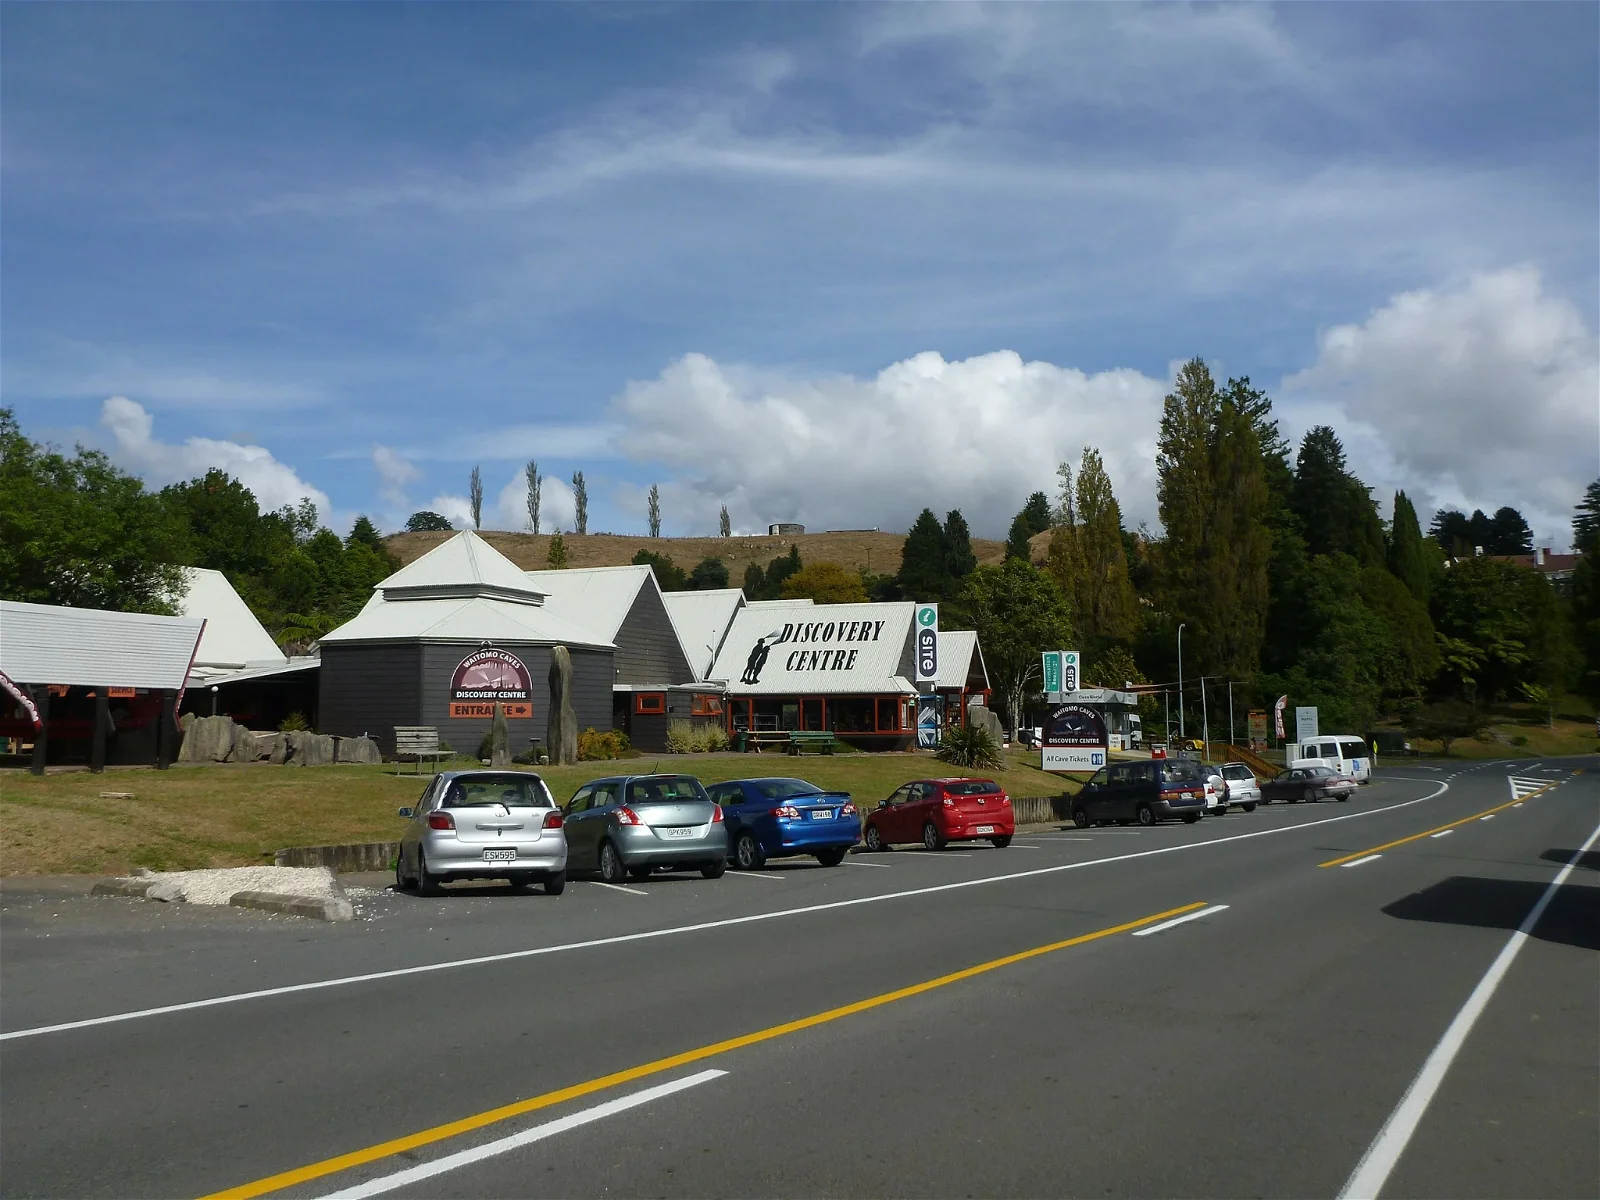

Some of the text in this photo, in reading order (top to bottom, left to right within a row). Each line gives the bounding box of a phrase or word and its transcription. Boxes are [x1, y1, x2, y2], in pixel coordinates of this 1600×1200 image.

[780, 620, 885, 643] DISCOVERY
[463, 651, 521, 669] WAITOMO CAVES
[786, 650, 858, 671] CENTRE
[1053, 705, 1095, 719] WAITOMO CAVES
